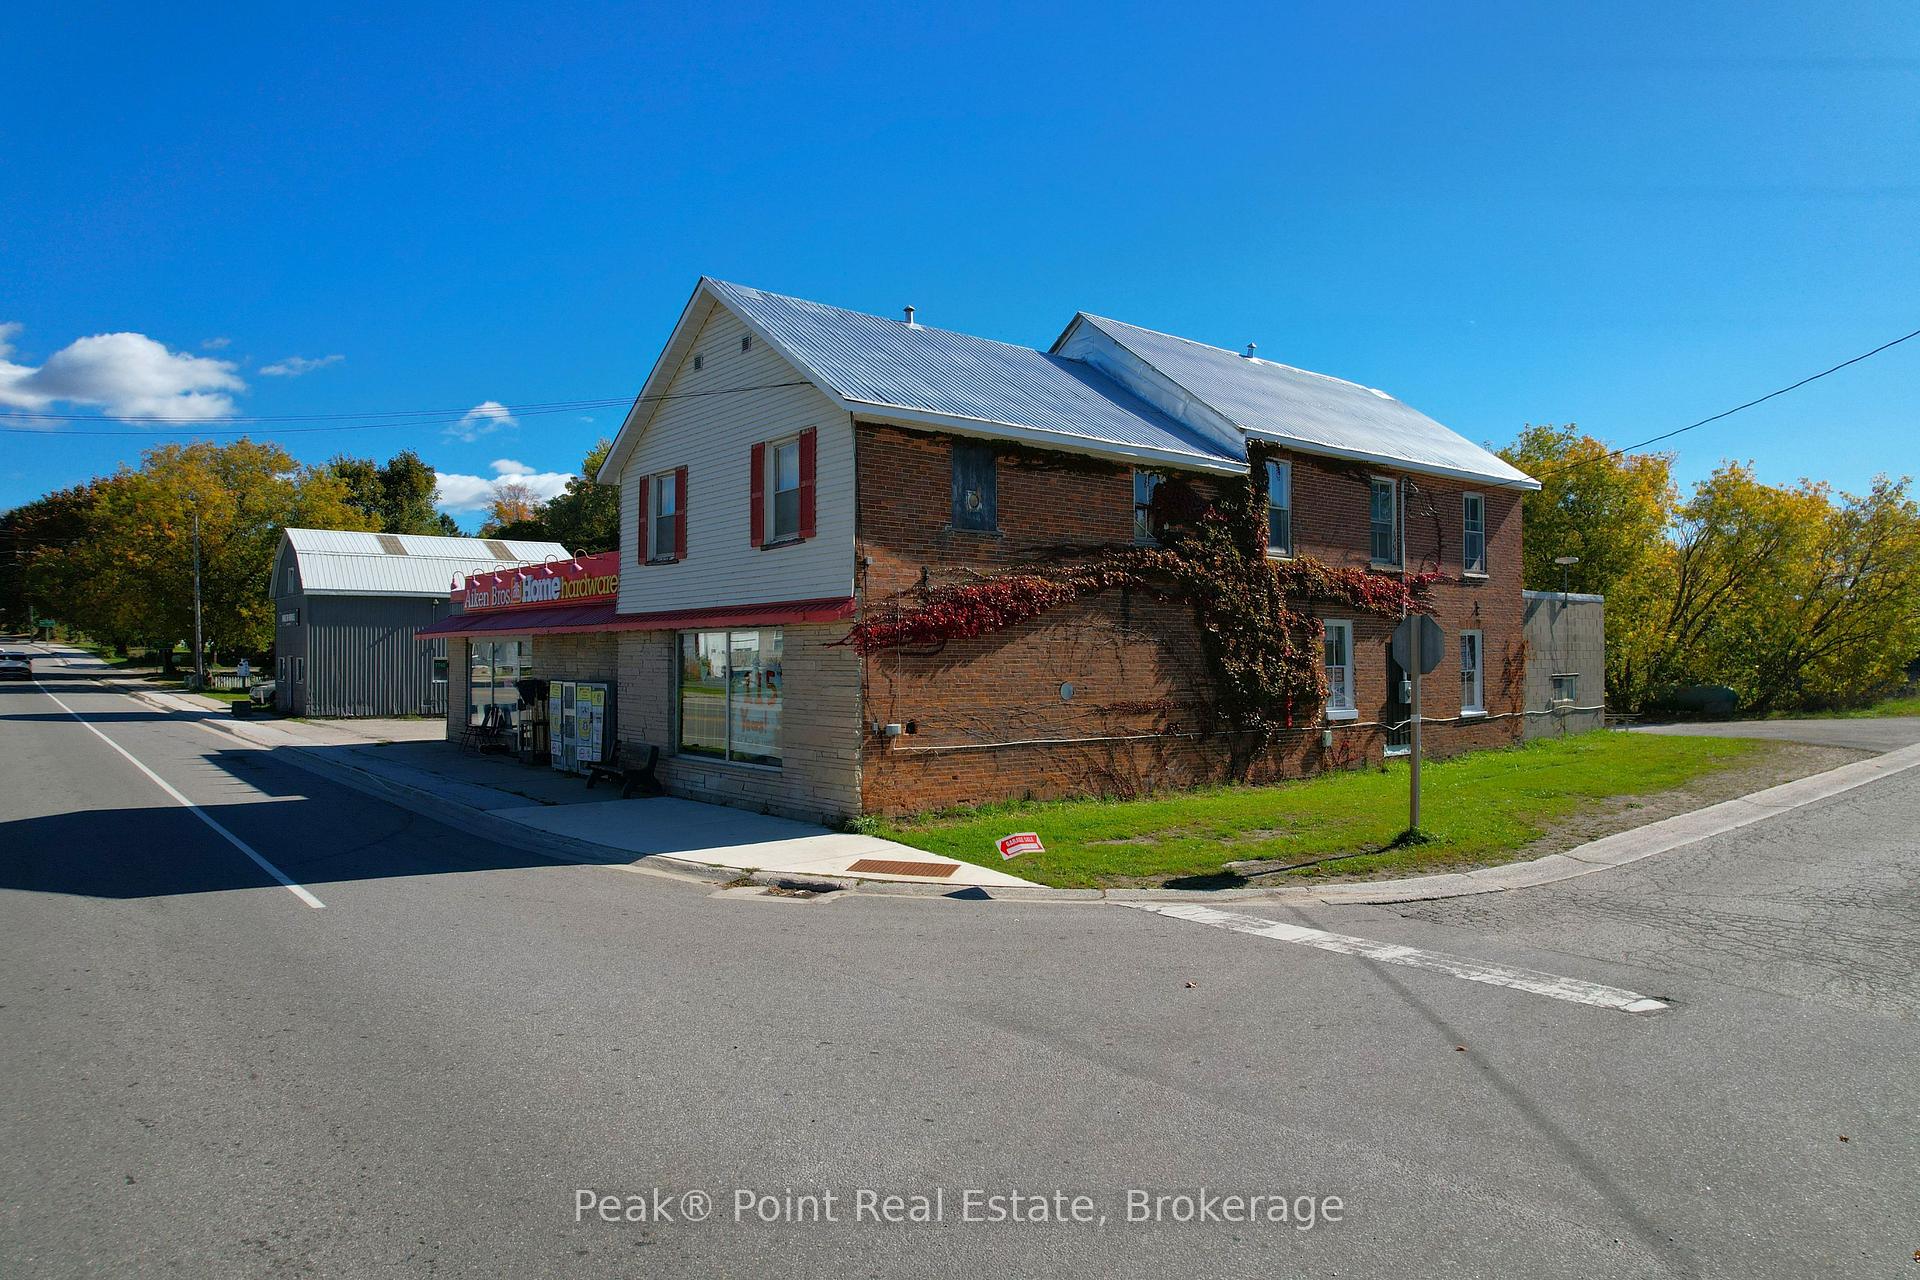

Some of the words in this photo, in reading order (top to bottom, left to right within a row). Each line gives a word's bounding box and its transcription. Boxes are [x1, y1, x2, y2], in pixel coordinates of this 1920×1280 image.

[464, 588, 490, 608] Aiken
[522, 574, 560, 603] Home
[561, 573, 619, 599] hardware
